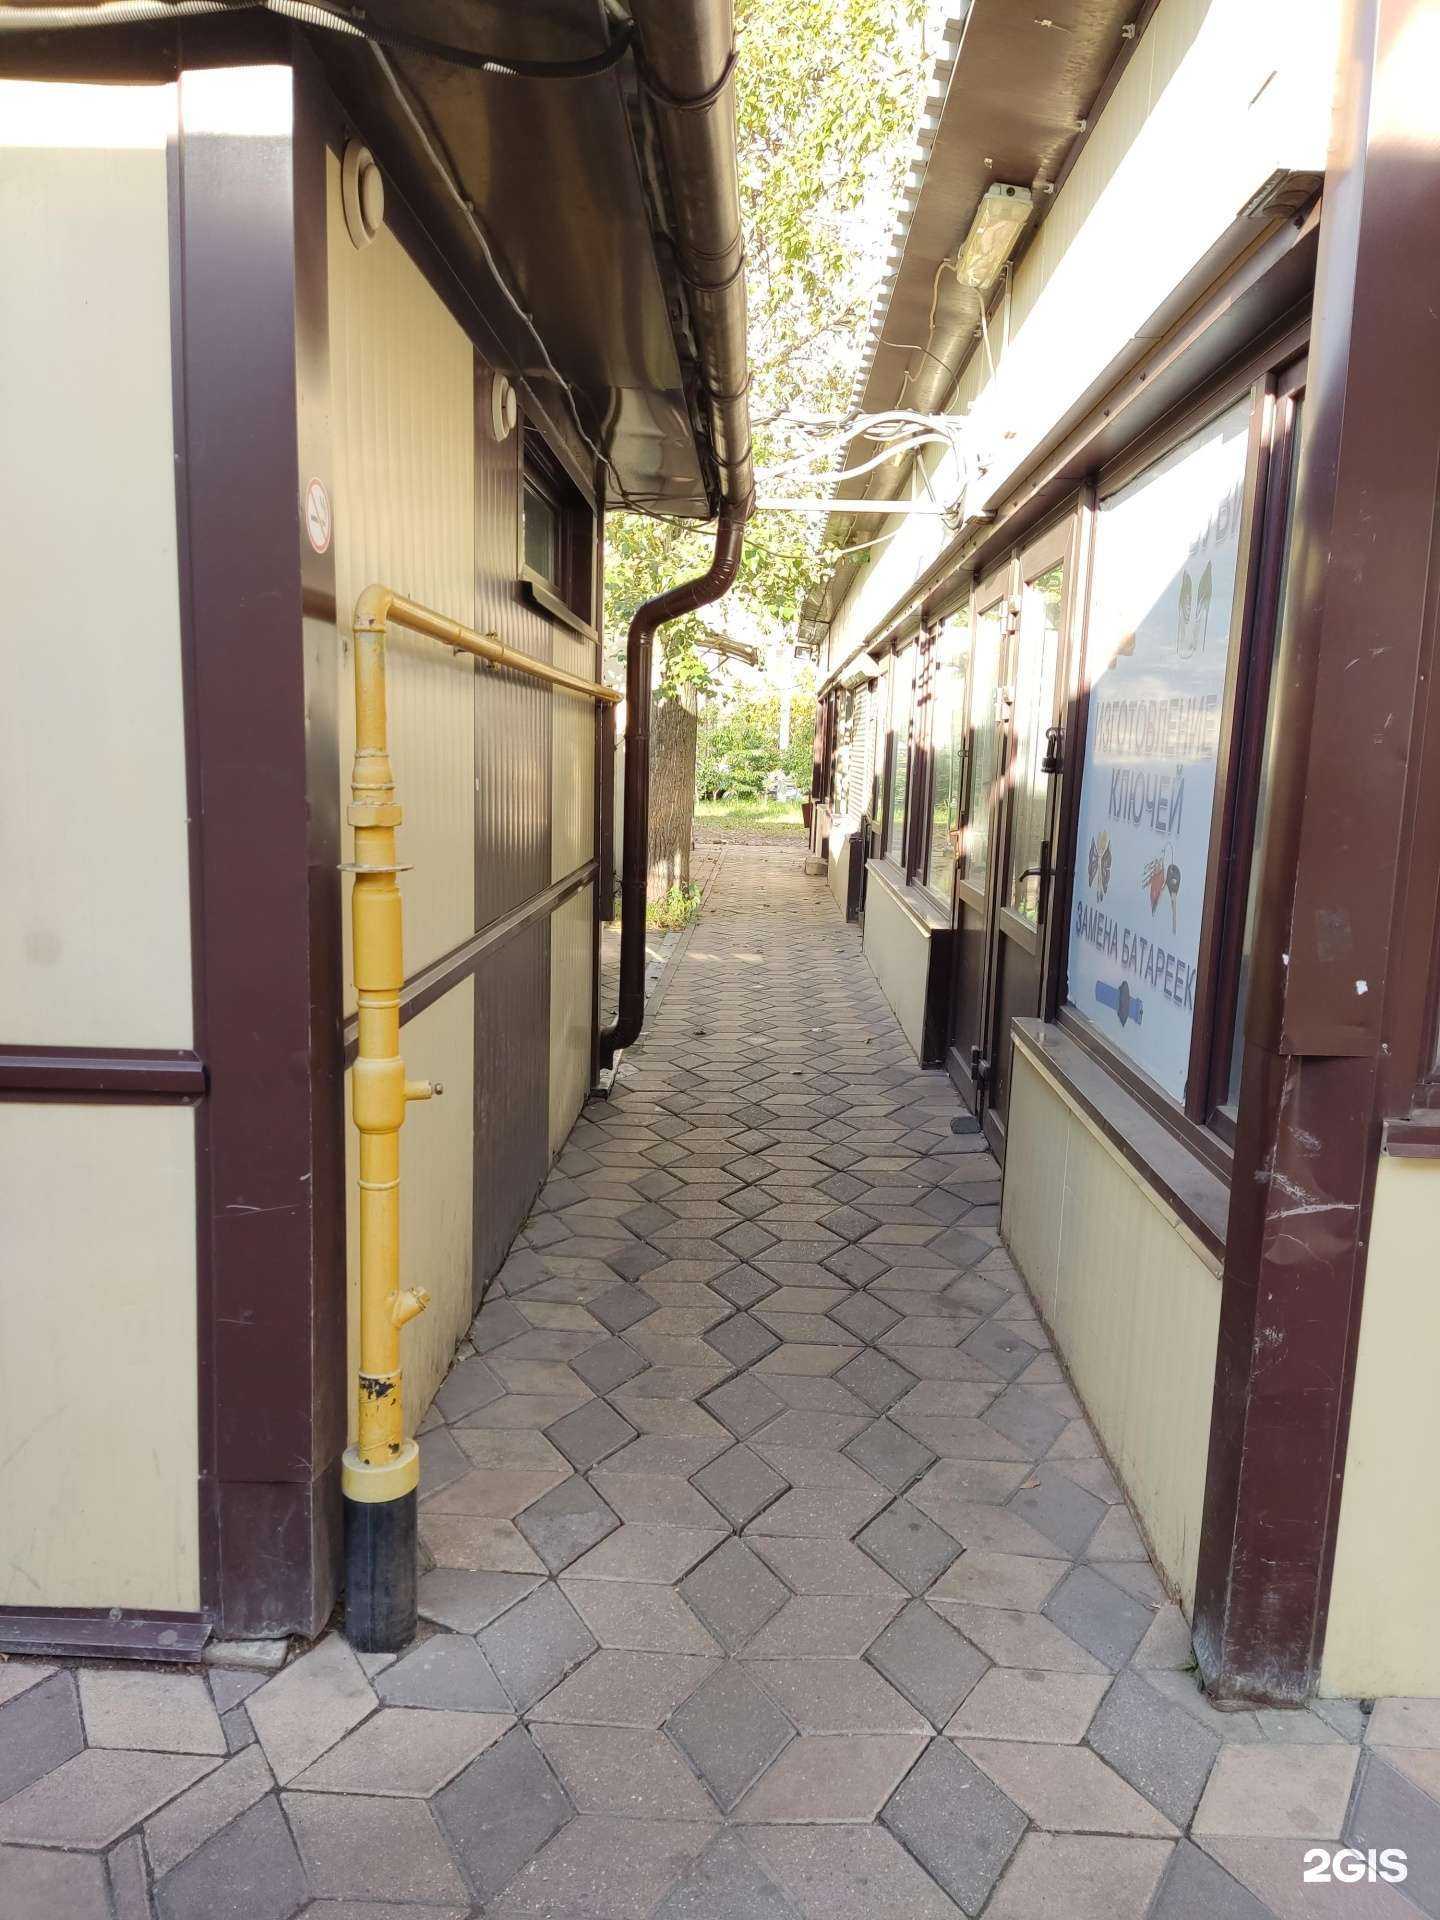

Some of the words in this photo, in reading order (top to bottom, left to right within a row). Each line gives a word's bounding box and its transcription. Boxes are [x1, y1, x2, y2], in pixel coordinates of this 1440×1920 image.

[1096, 695, 1218, 760] ИЗГОТОВЛЕНИЕ
[1109, 765, 1185, 834] КЛЮЧЕЙ
[1076, 901, 1119, 961] ЗАМЕНА
[1120, 928, 1196, 1011] БАТАРЕЕК
